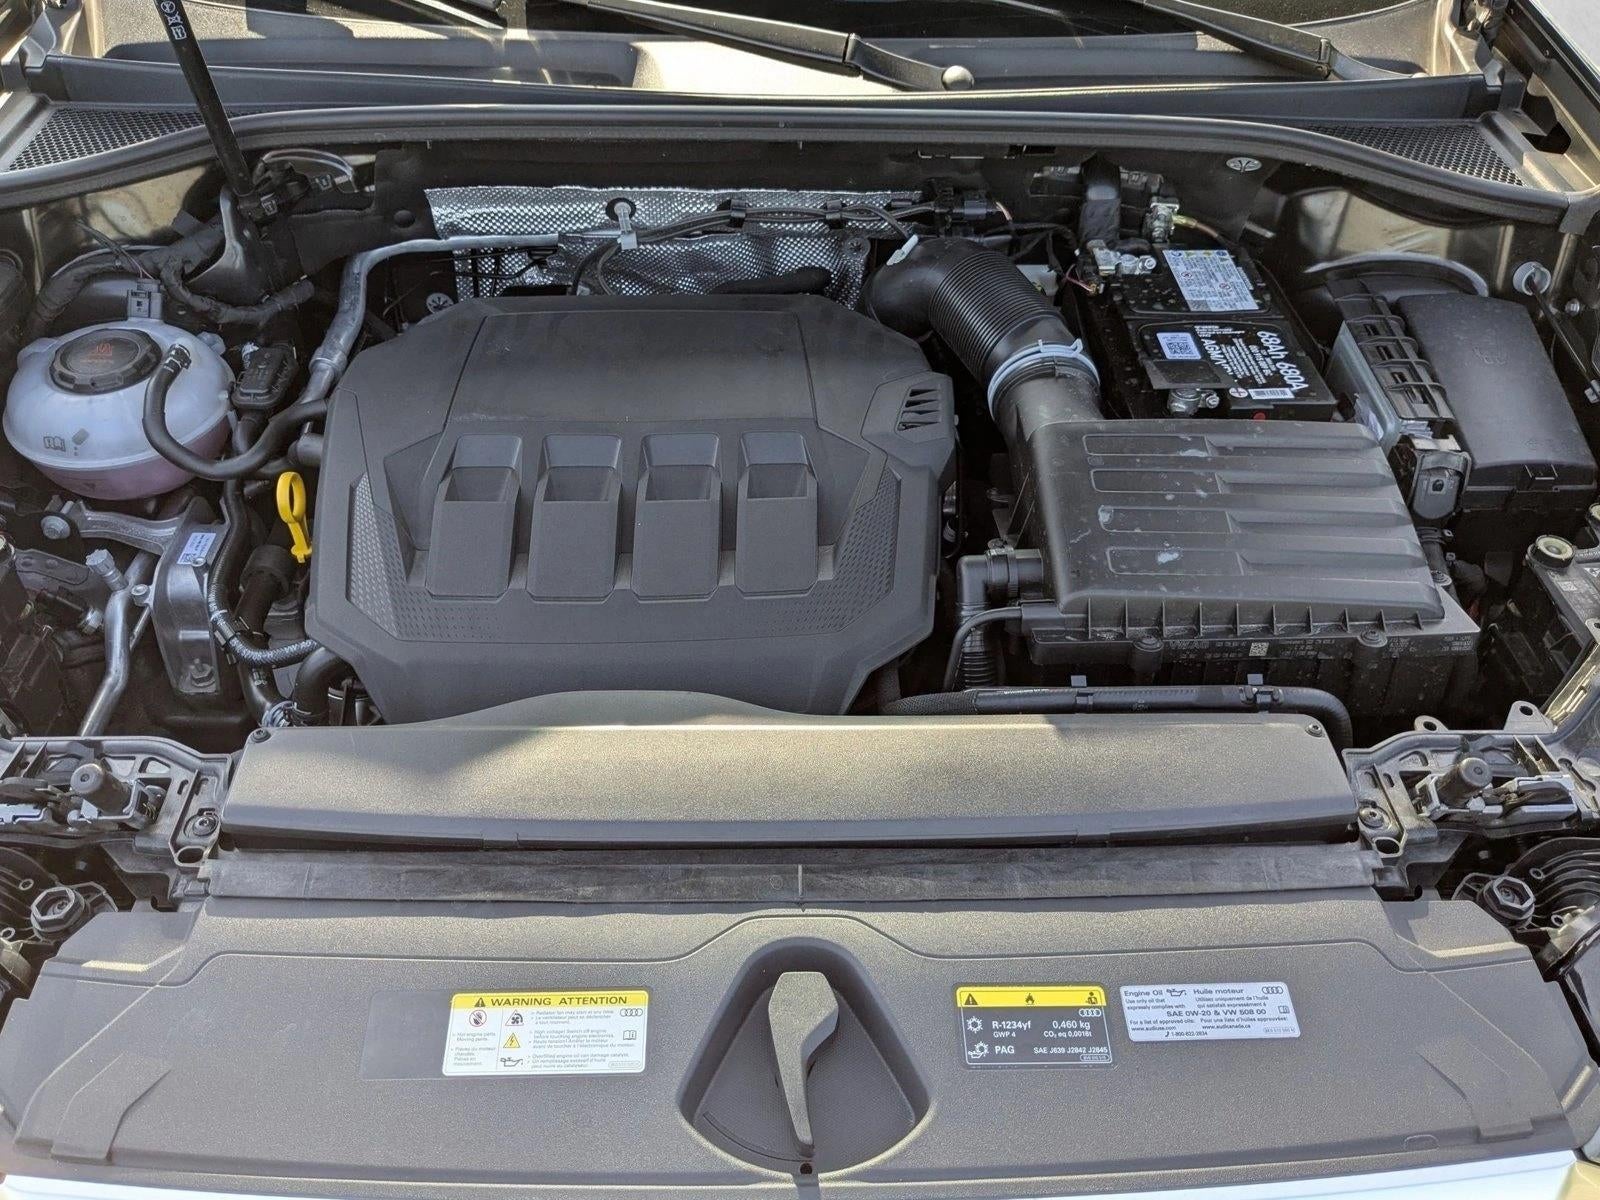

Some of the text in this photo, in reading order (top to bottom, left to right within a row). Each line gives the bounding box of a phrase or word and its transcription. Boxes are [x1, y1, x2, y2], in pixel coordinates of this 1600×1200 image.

[1257, 331, 1289, 359] 68Ah
[1276, 362, 1309, 392] 680A
[1124, 989, 1163, 998] Engine Oil
[491, 996, 628, 1006] WARNING ATTENTION
[992, 1020, 1031, 1031] R-1234yf
[1079, 1020, 1091, 1030] kg
[994, 1045, 1015, 1054] PAG
